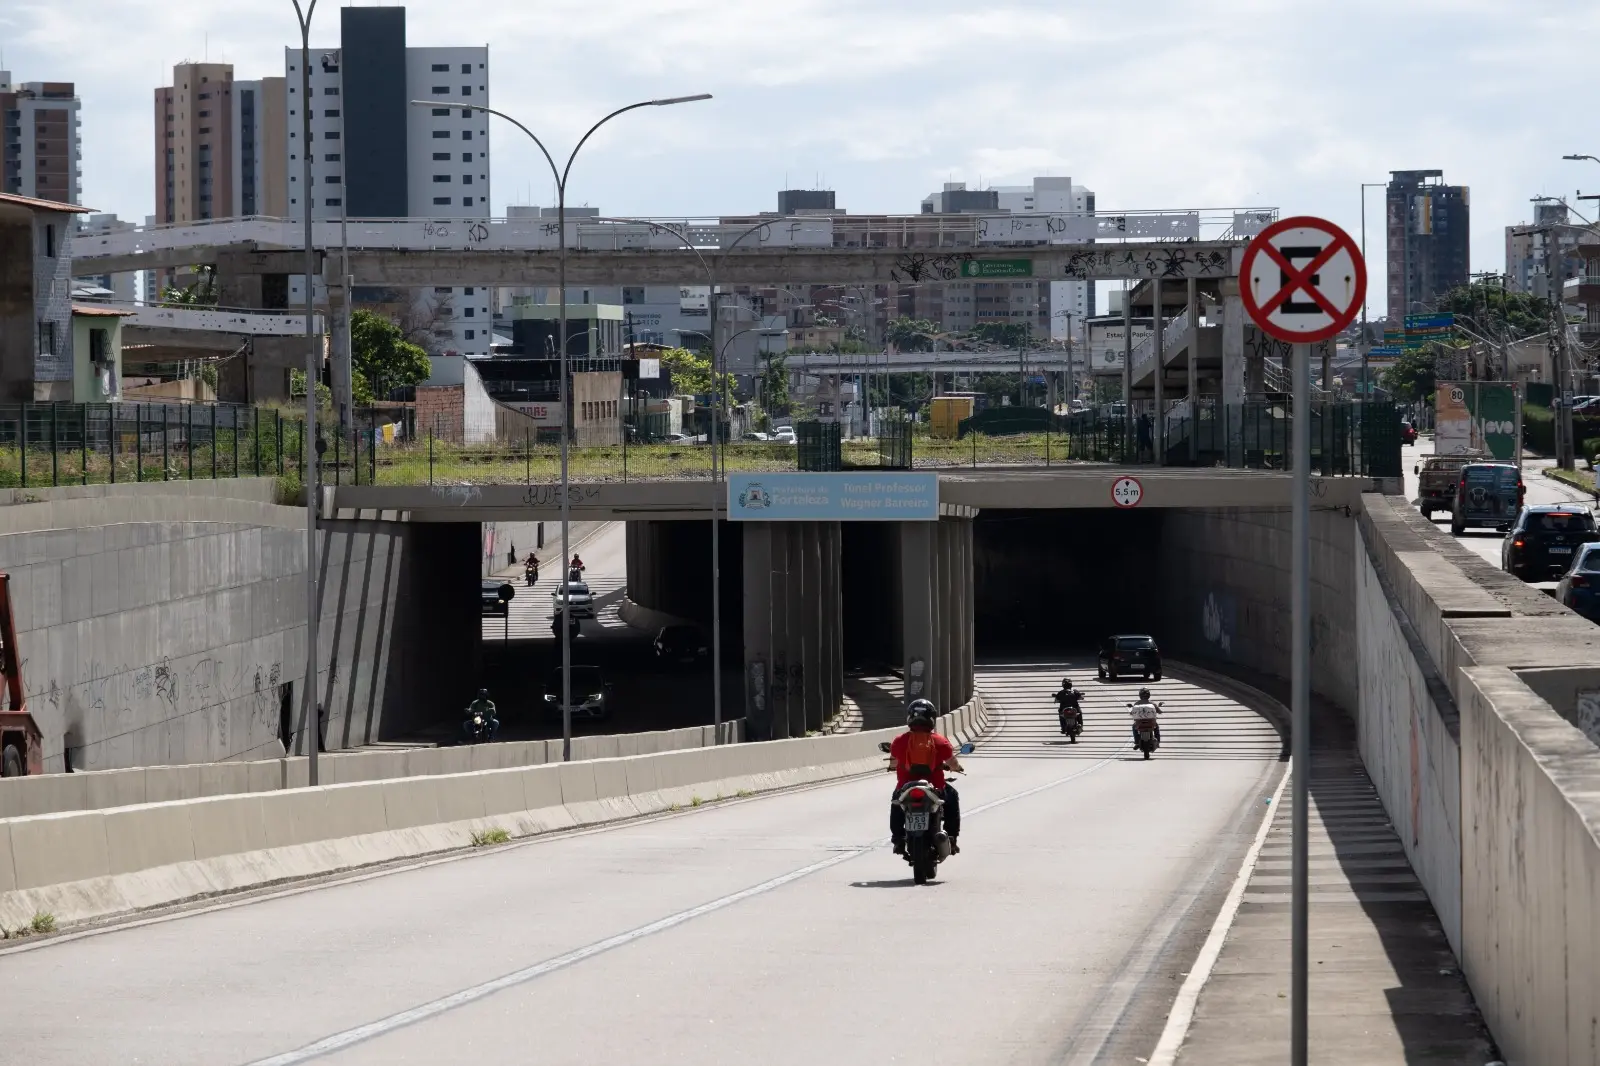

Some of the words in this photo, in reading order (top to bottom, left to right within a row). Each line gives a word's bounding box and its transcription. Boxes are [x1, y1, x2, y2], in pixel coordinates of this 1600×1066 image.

[1451, 390, 1463, 400] 80
[875, 481, 927, 494] Professor
[772, 494, 829, 505] Fortaleza
[840, 498, 883, 510] Wagner
